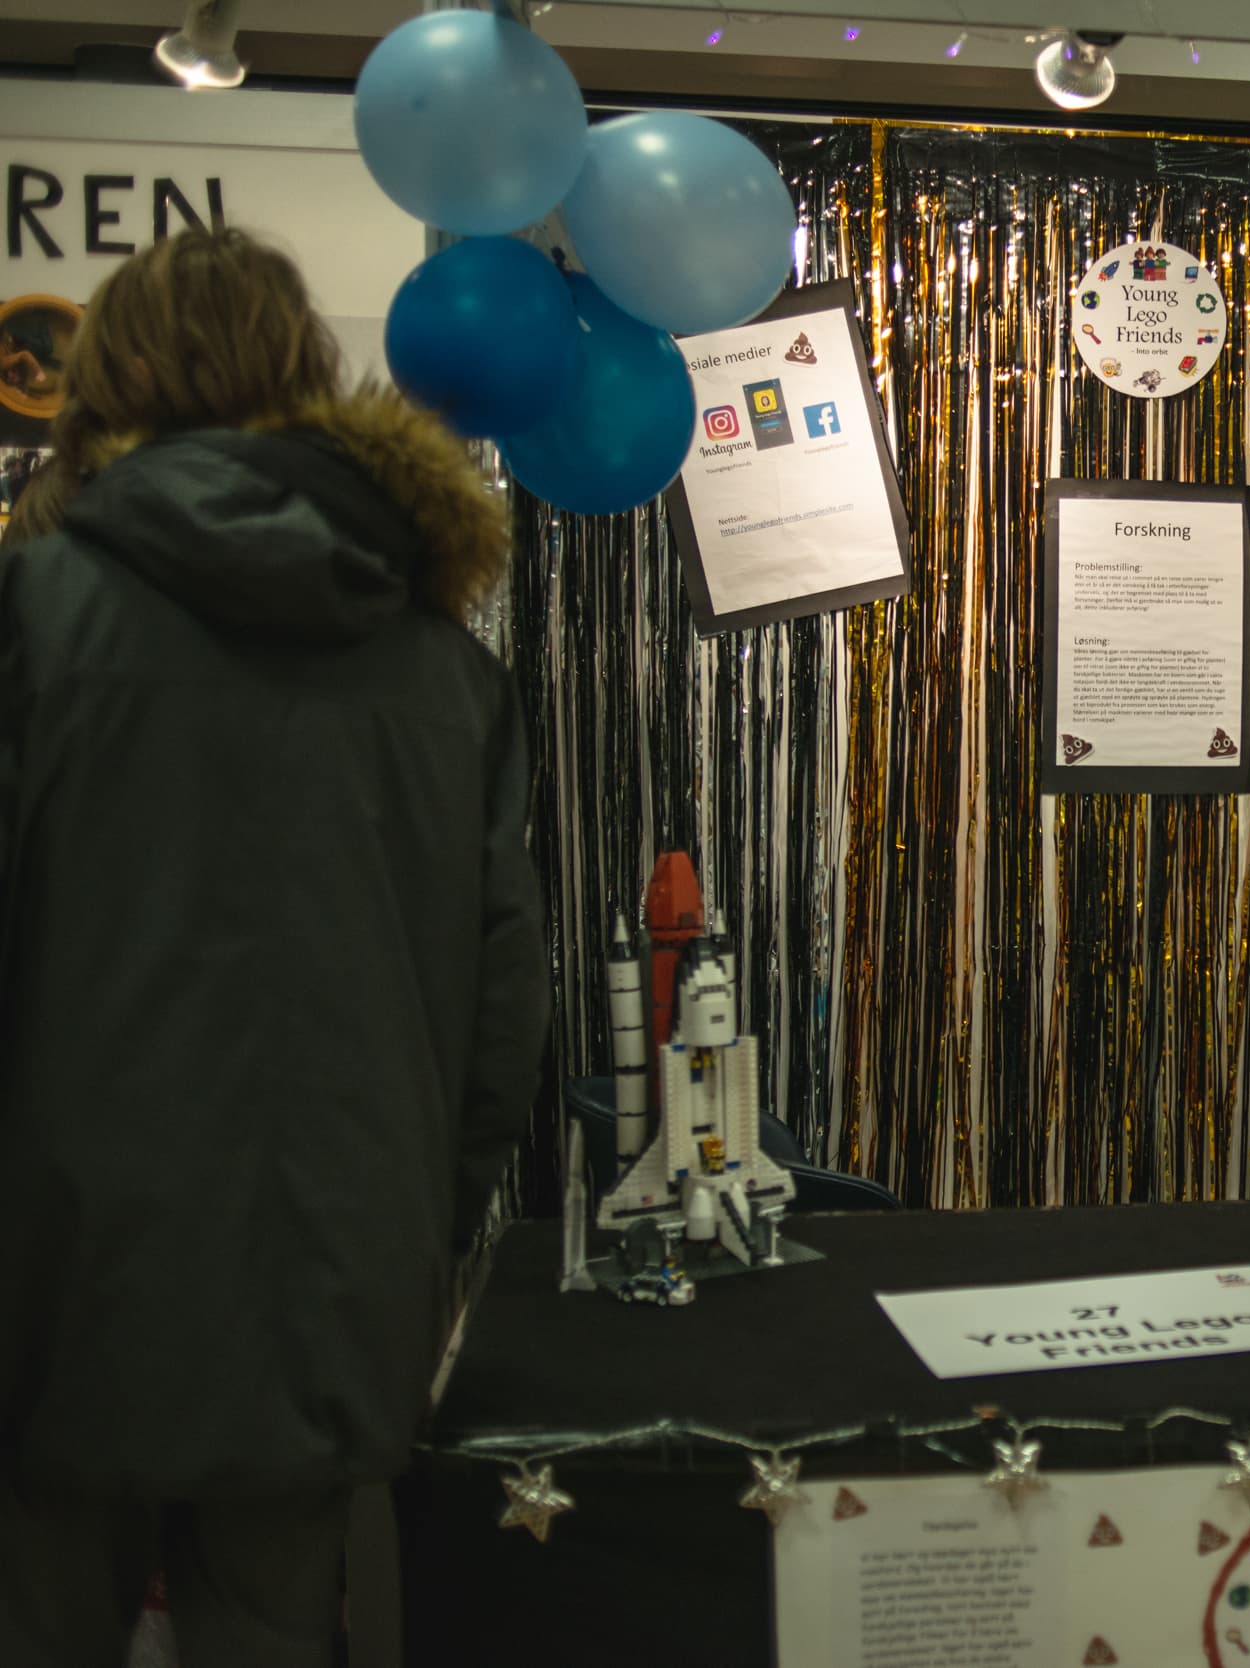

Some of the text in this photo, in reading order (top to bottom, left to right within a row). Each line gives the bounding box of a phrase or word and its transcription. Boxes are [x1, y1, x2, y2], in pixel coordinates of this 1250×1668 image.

[1121, 285, 1179, 307] Young
[1127, 306, 1167, 327] Lego
[1116, 327, 1183, 344] Friends
[687, 346, 772, 371] siale medier
[699, 440, 752, 459] Instagram
[1114, 522, 1191, 541] Forskning
[1074, 563, 1143, 573] Problemstilling:
[1073, 637, 1111, 647] Løsning:
[1070, 1305, 1121, 1321] 27
[966, 1323, 1130, 1348] Young
[1039, 1333, 1230, 1361] Friends
